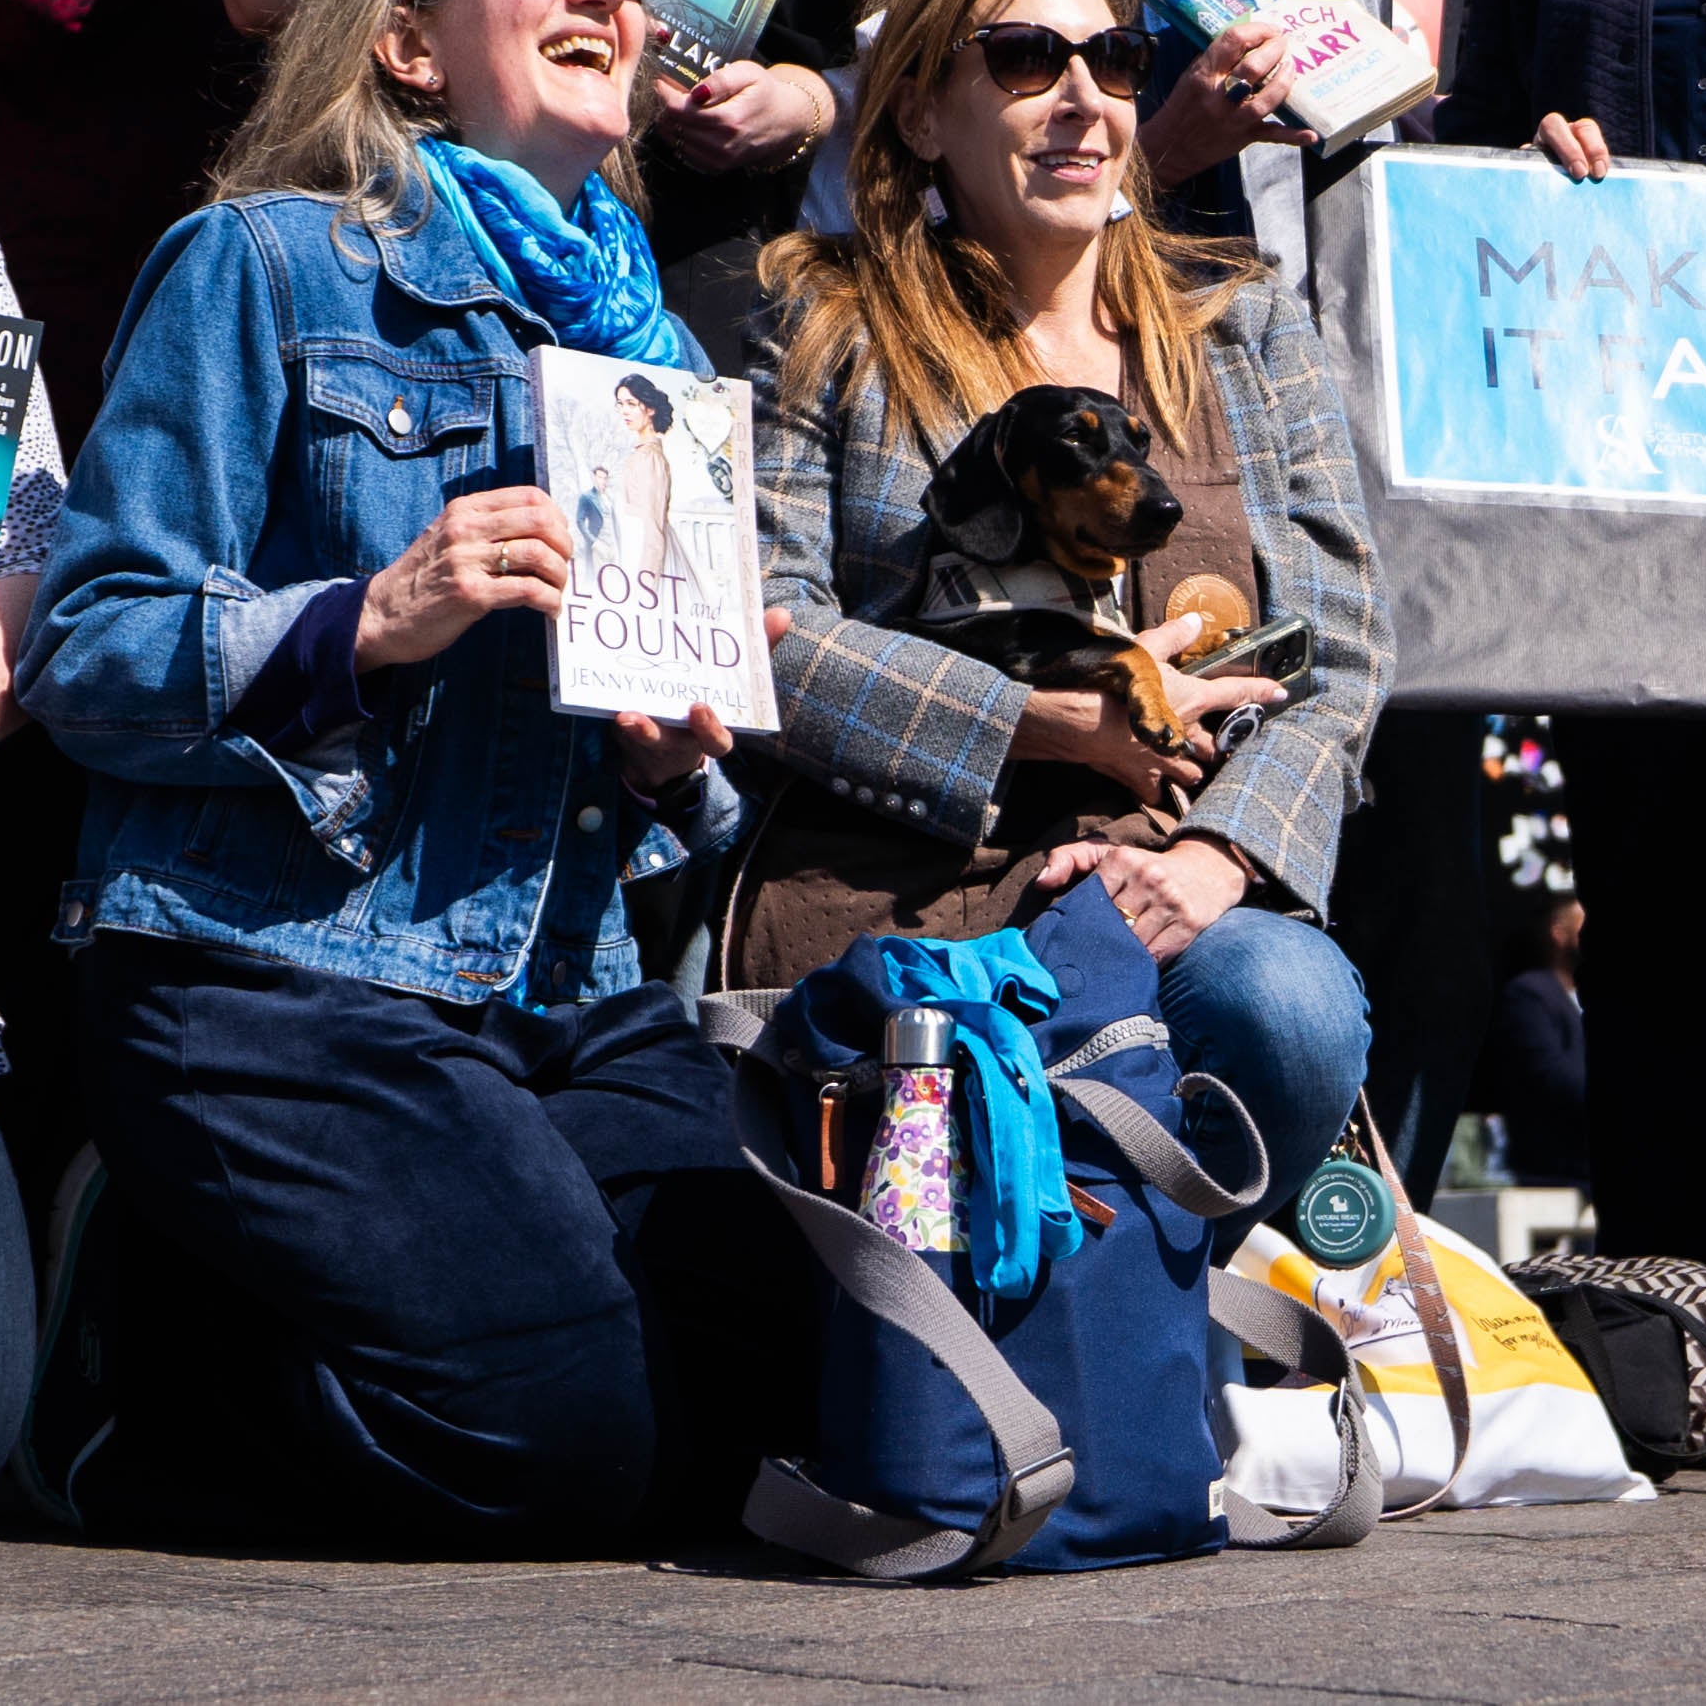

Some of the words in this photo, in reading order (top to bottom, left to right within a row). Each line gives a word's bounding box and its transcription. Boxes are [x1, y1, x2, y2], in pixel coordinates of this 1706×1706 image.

[660, 11, 712, 46] BESTSELLER
[1483, 326, 1565, 391] IT
[570, 558, 687, 616] LOST
[690, 599, 723, 622] and
[567, 604, 742, 669] FOUND
[570, 666, 637, 694] JENNY
[638, 678, 749, 710] WORSTALL
